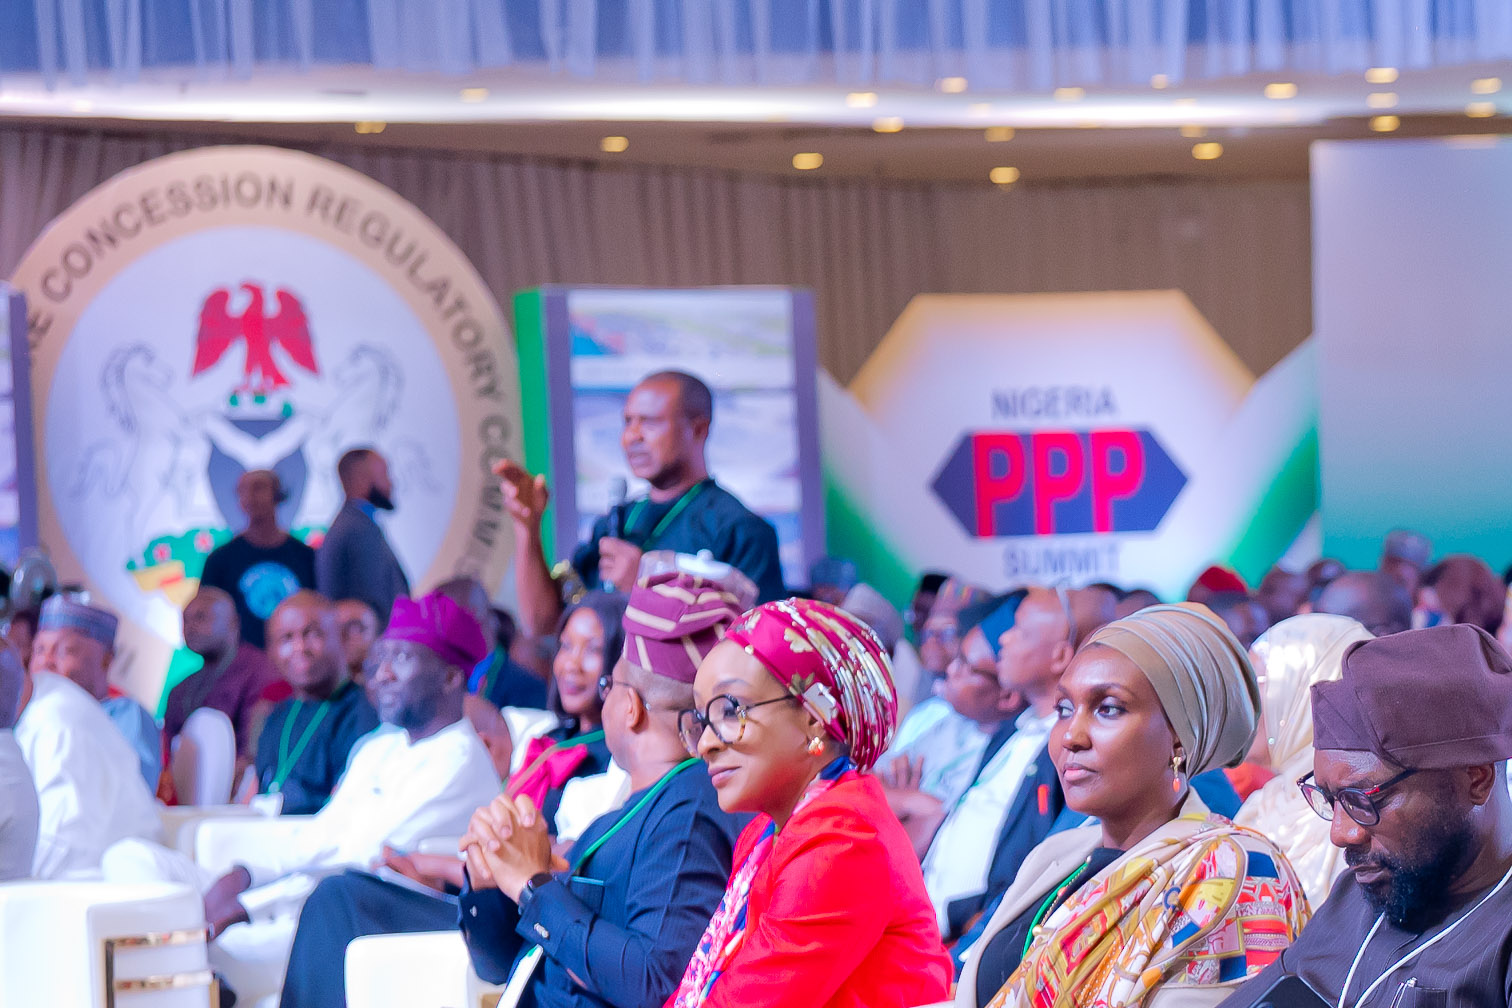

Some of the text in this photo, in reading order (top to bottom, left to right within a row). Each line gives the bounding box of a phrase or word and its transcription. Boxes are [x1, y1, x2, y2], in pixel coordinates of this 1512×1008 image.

[41, 170, 295, 302] CONCESSION
[303, 186, 502, 398] REGULATORY
[991, 386, 1117, 418] NIGERIA
[972, 429, 1145, 539] PPP
[1003, 544, 1121, 577] SUMMIT
